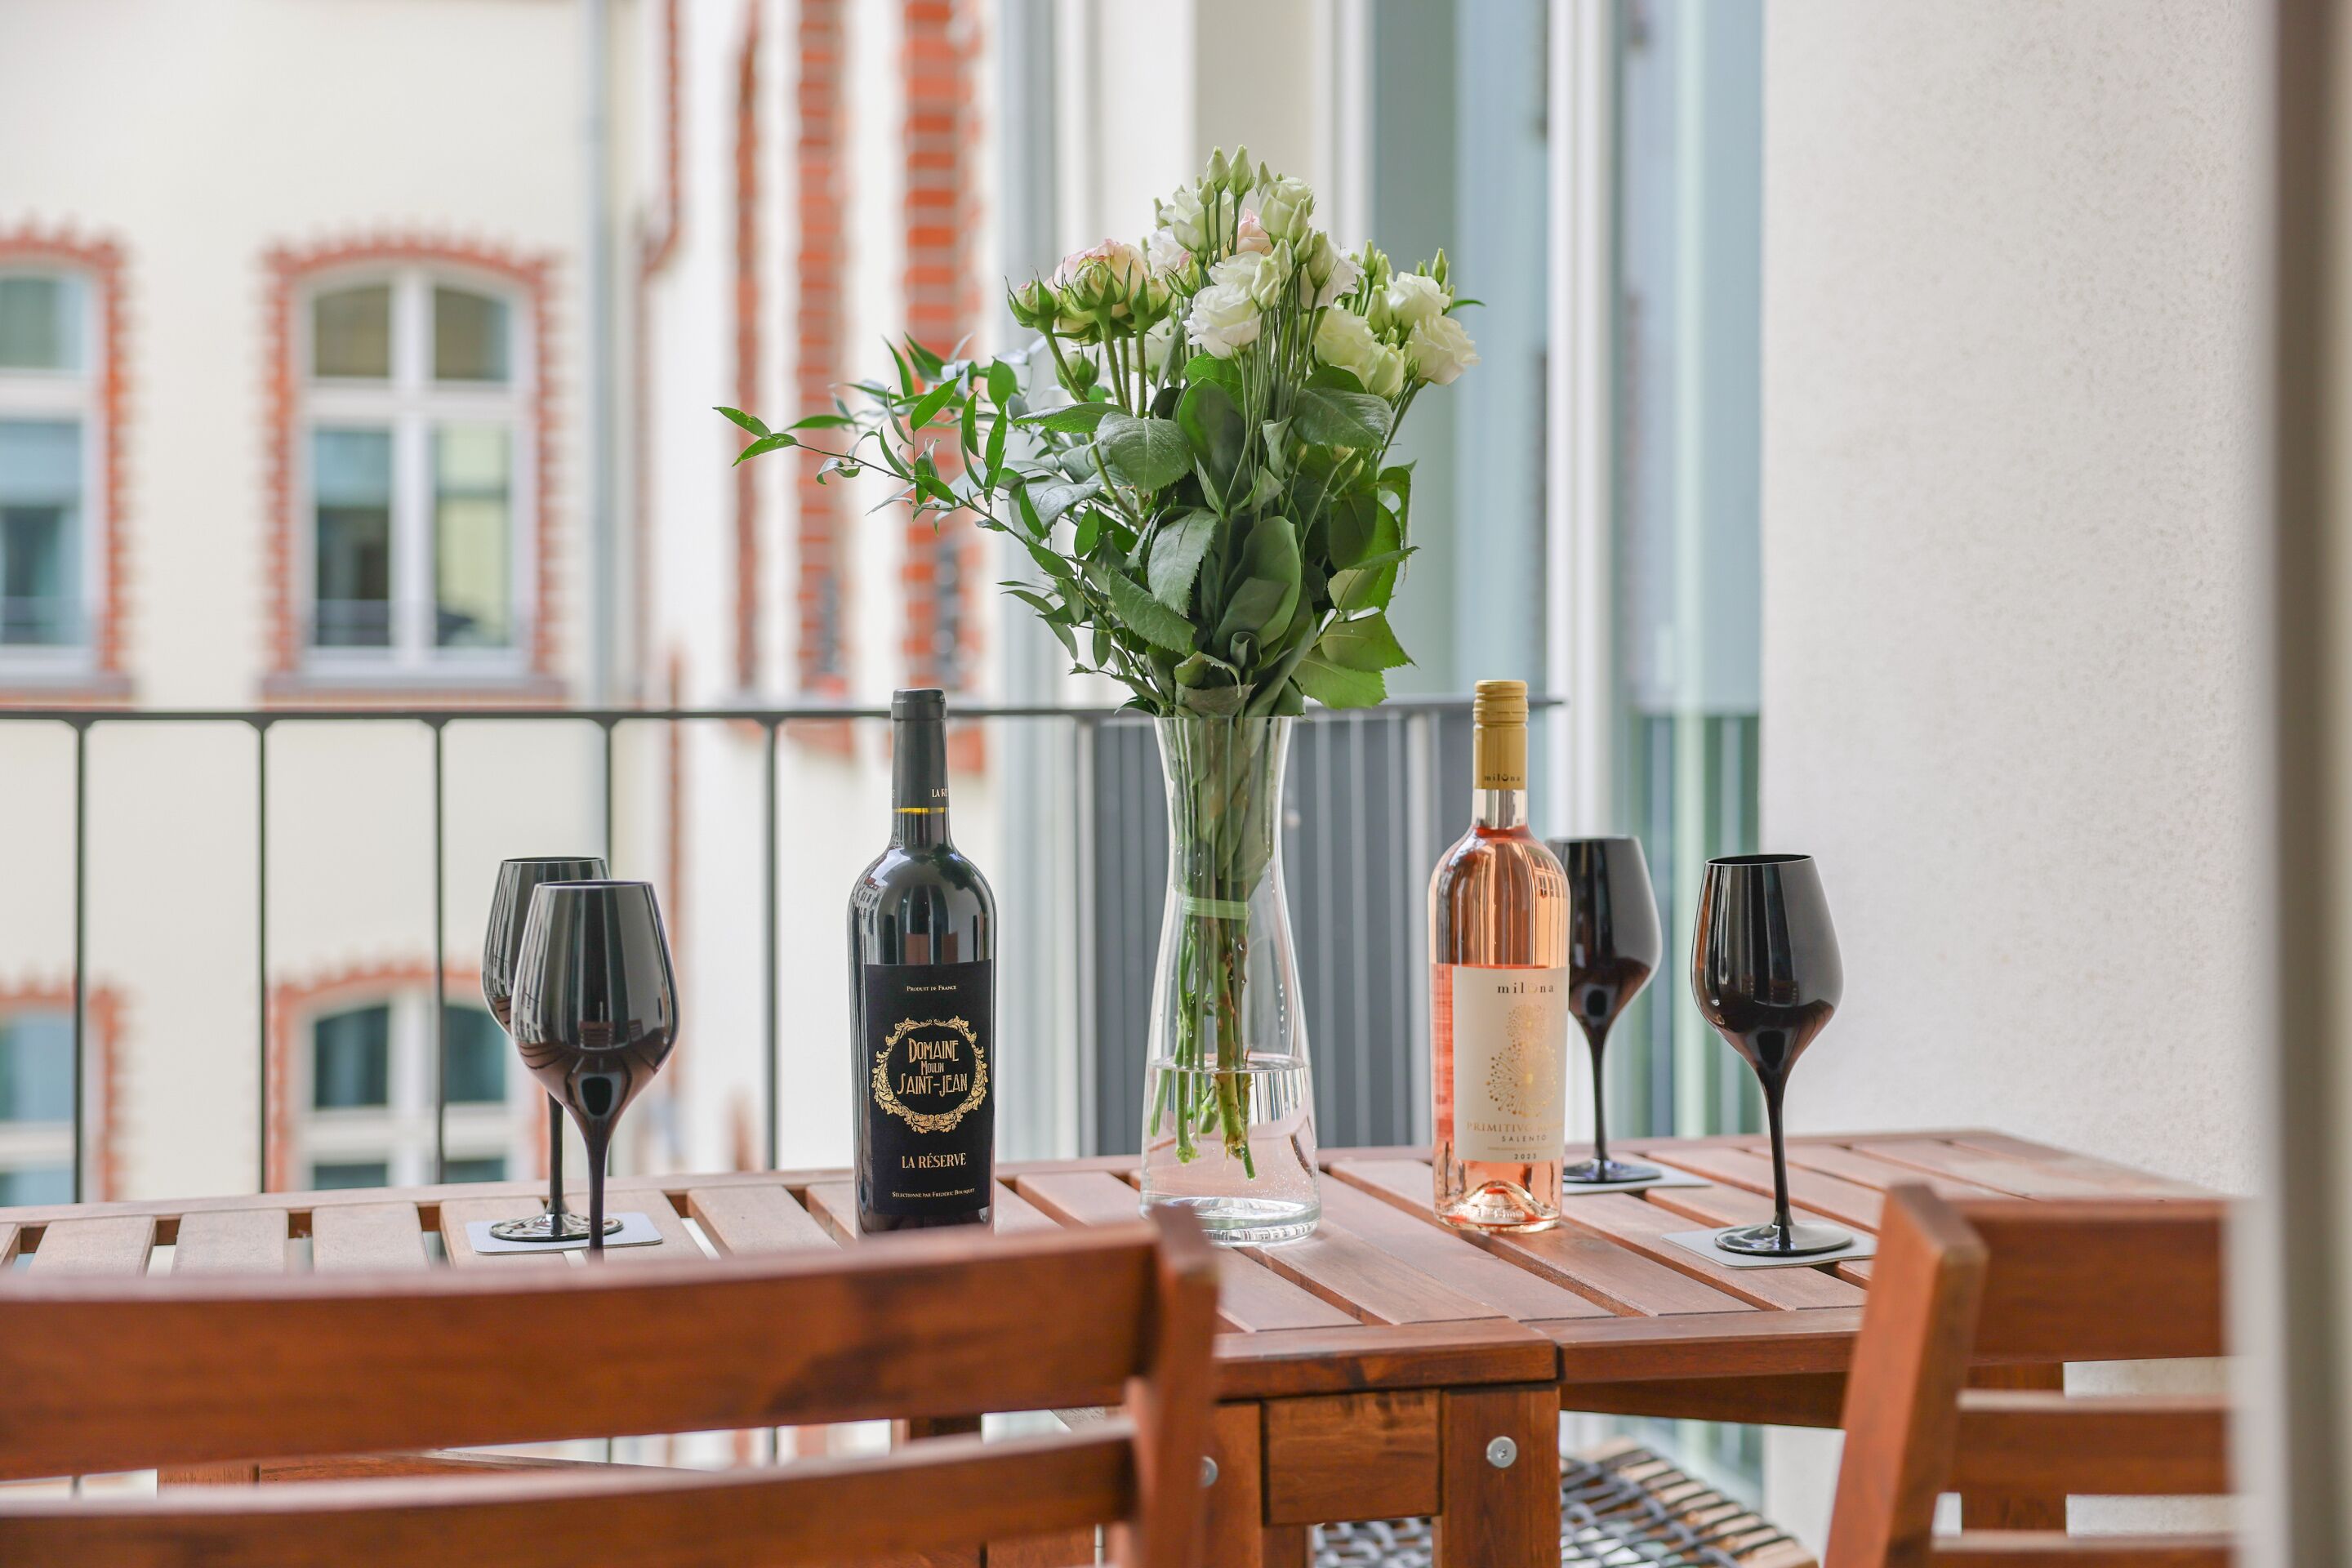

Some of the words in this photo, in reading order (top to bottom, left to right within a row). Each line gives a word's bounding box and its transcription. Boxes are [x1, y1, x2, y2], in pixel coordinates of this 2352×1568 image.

[932, 788, 941, 798] LA
[1502, 1134, 1548, 1143] SALENTO
[902, 1156, 915, 1169] LA
[918, 1152, 967, 1169] RÉSERVE
